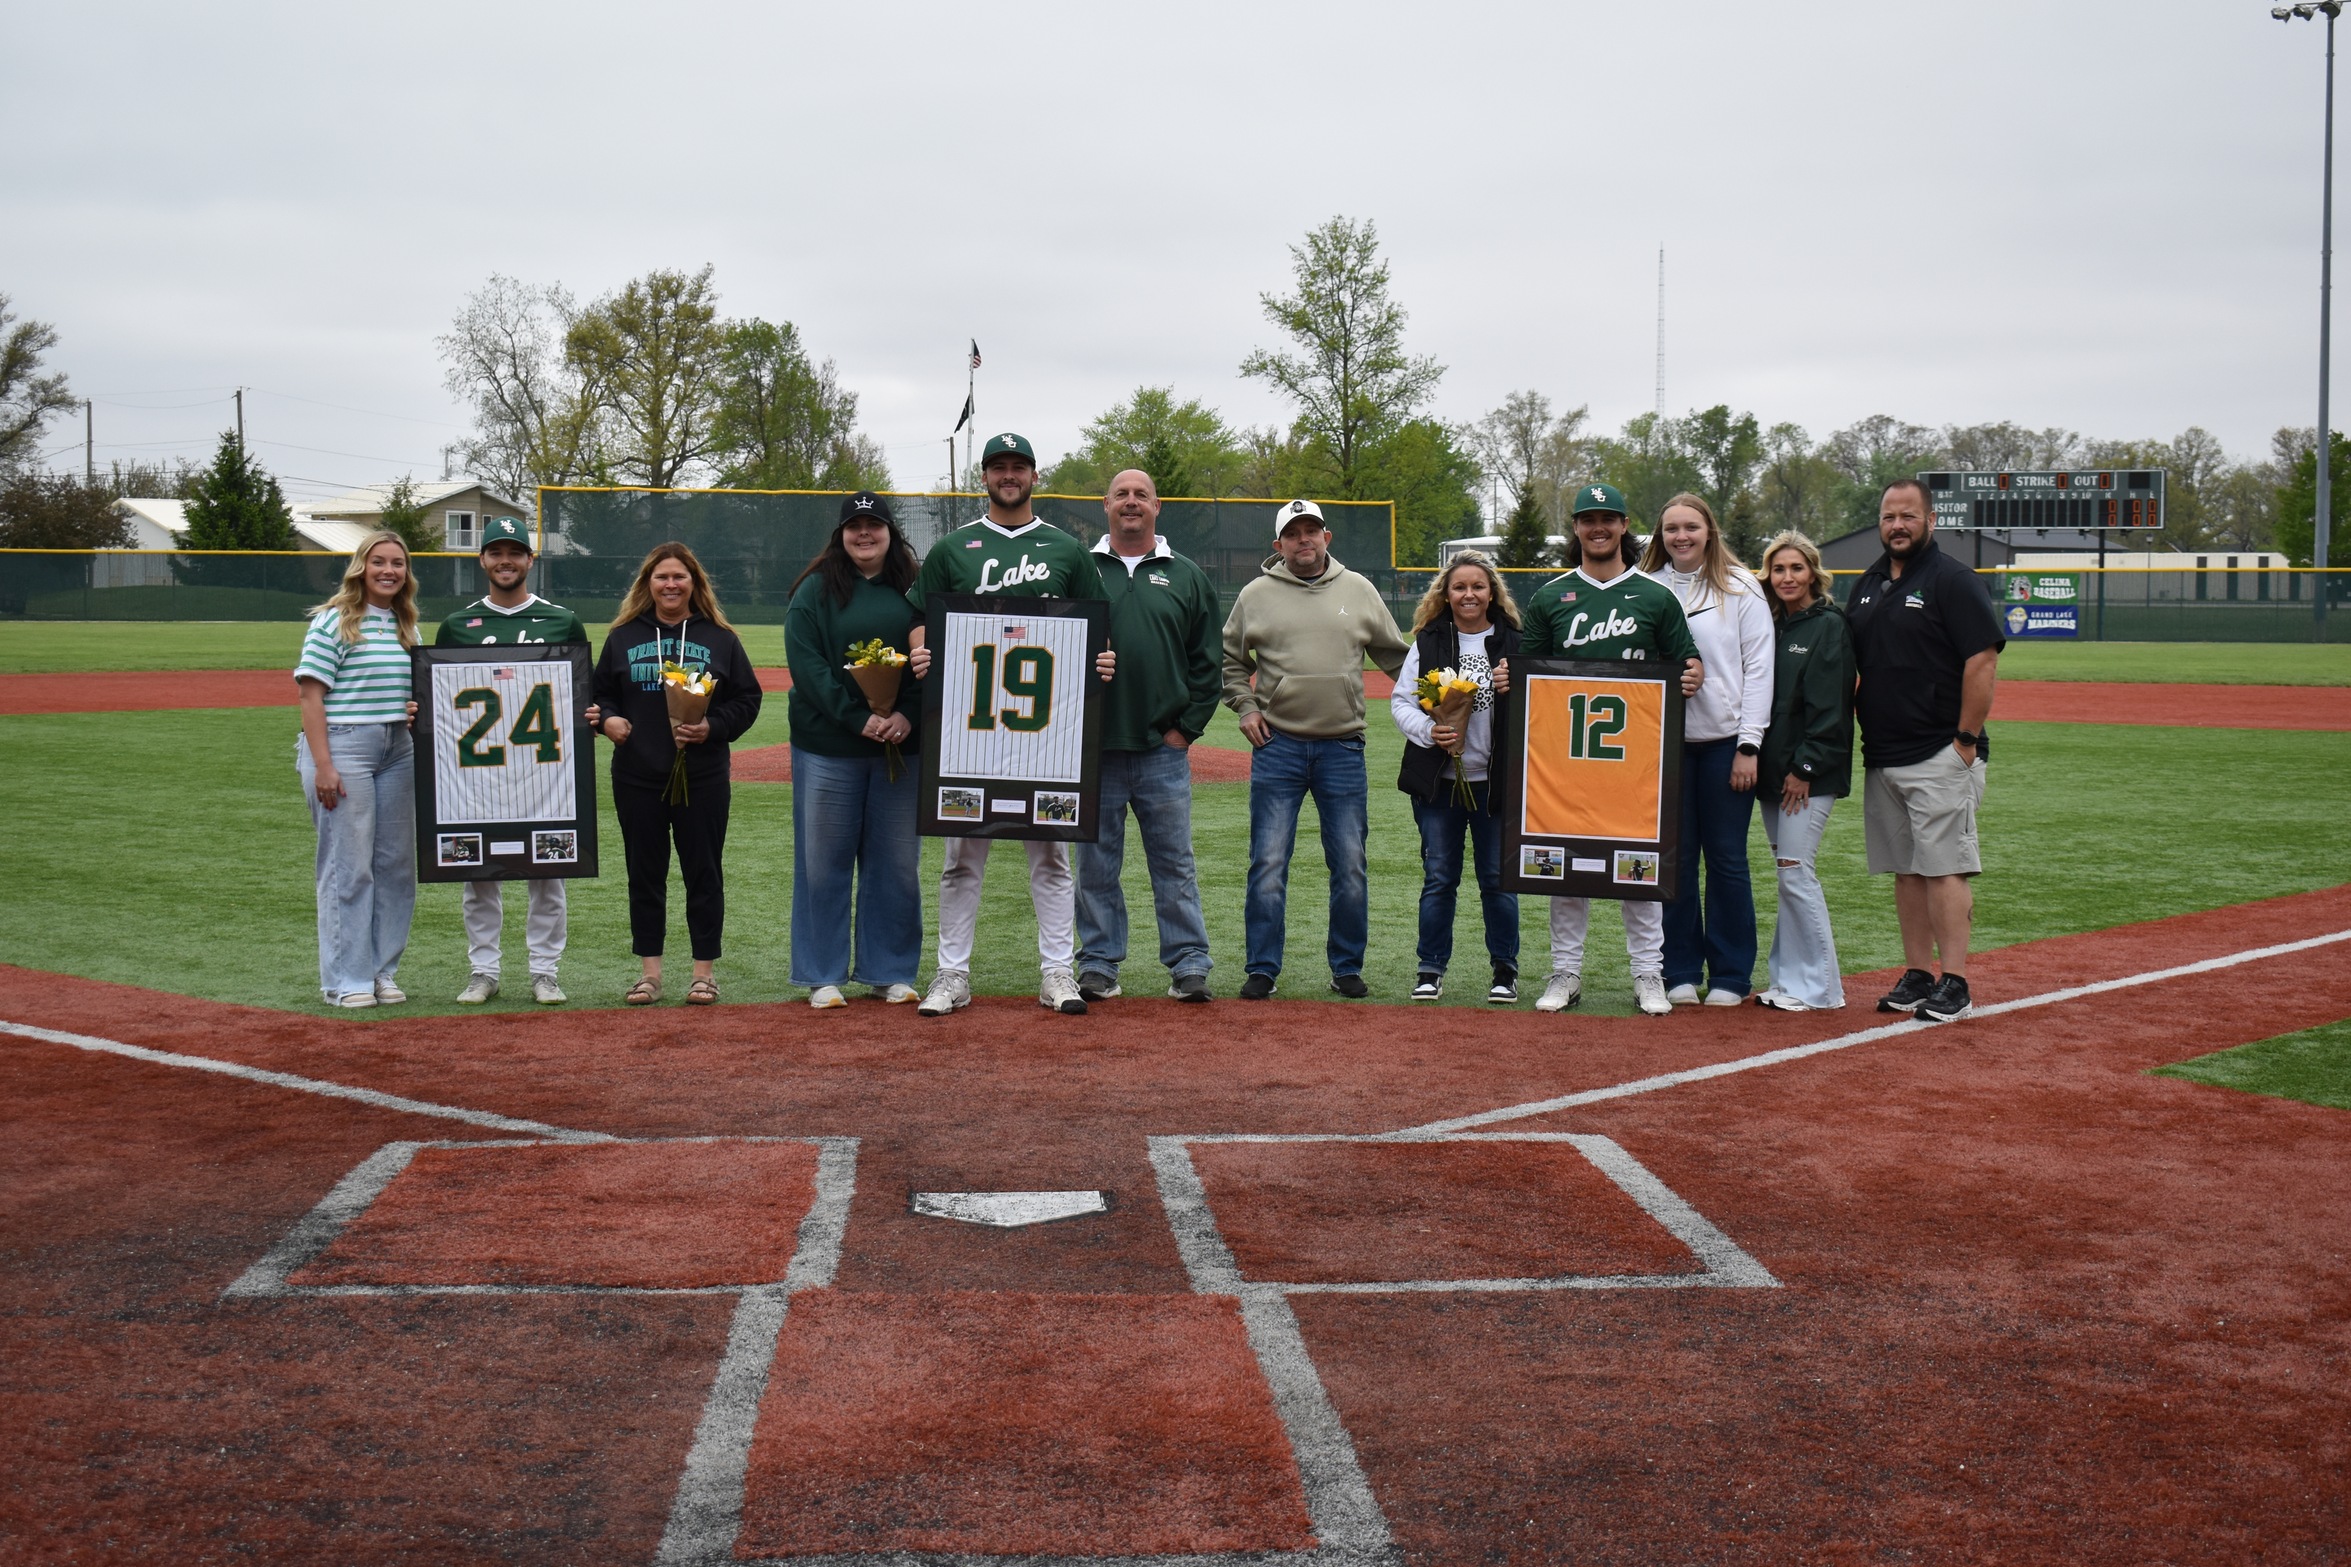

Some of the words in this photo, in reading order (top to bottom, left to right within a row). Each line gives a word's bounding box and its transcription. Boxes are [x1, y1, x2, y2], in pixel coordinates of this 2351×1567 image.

[1001, 434, 1017, 448] WSU
[1968, 476, 1997, 487] BALL
[1999, 474, 2009, 490] 0
[2016, 476, 2056, 487] STRIKE
[2057, 473, 2068, 489] 0
[2074, 475, 2098, 487] OUT
[2100, 473, 2110, 489] 0
[1590, 487, 1606, 502] WSU
[1977, 492, 1982, 500] 1
[2012, 491, 2018, 499] 4
[2035, 491, 2042, 499] 6
[2081, 491, 2092, 499] 10
[2108, 500, 2117, 513] 0
[2133, 500, 2142, 513] 0
[2148, 500, 2157, 513] 0
[500, 519, 515, 534] WSU
[1934, 516, 1964, 526] OME
[2108, 514, 2116, 526] 0
[2133, 514, 2141, 527] 0
[2148, 514, 2157, 527] 0
[975, 554, 1050, 595] Lake
[2039, 578, 2071, 587] CELINA
[2033, 587, 2076, 599] BASEBALL
[1563, 608, 1637, 648] Lake
[2028, 619, 2076, 629] MARINERS
[676, 640, 711, 664] STATE
[643, 683, 661, 691] LAKE
[967, 643, 1055, 733] 19
[454, 682, 562, 768] 24
[1568, 693, 1627, 762] 12
[548, 851, 559, 860] 24
